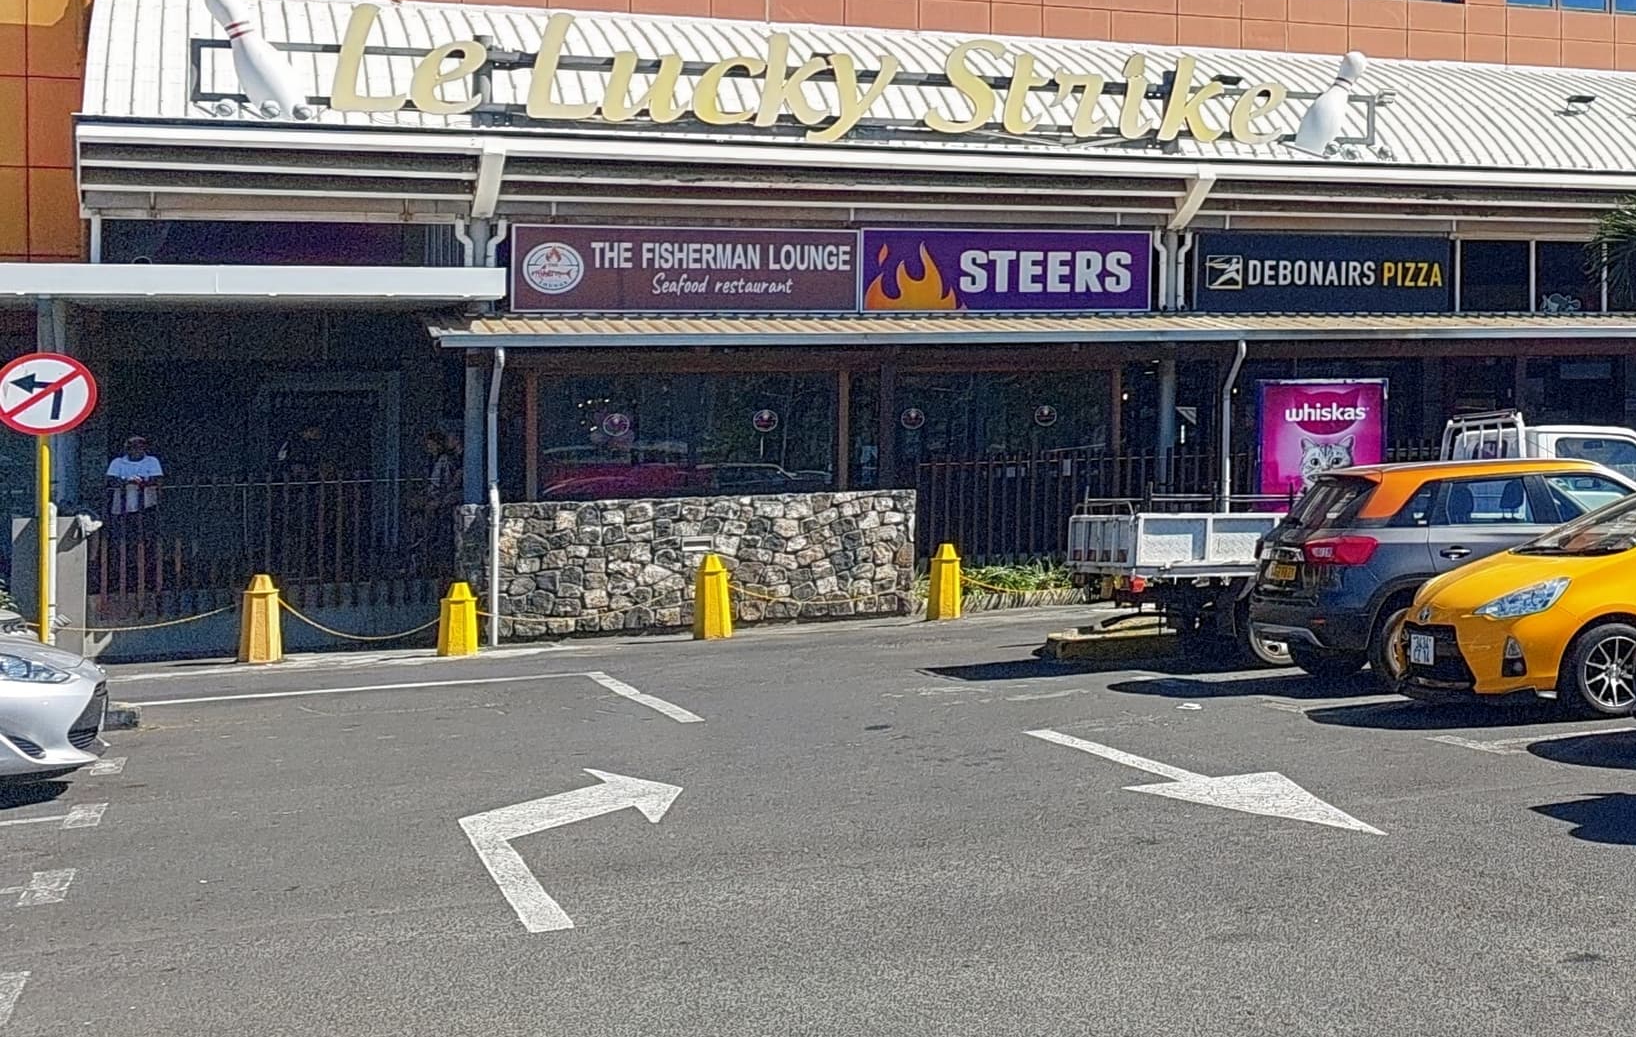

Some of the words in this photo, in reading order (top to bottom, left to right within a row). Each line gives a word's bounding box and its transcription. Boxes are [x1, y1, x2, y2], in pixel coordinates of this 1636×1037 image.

[330, 3, 486, 117] Le
[524, 13, 900, 145] Lucky
[925, 39, 1290, 146] Strike
[591, 242, 633, 269] THE
[641, 242, 761, 270] FISHERMAN
[768, 244, 851, 271] LOUNGE
[652, 272, 709, 296] Seafood
[714, 277, 794, 295] restaurant
[959, 250, 1133, 294] STEERS
[1247, 259, 1376, 287] DEBONAIRS
[1382, 262, 1443, 288] PIZZA
[1285, 402, 1366, 422] whiskas
